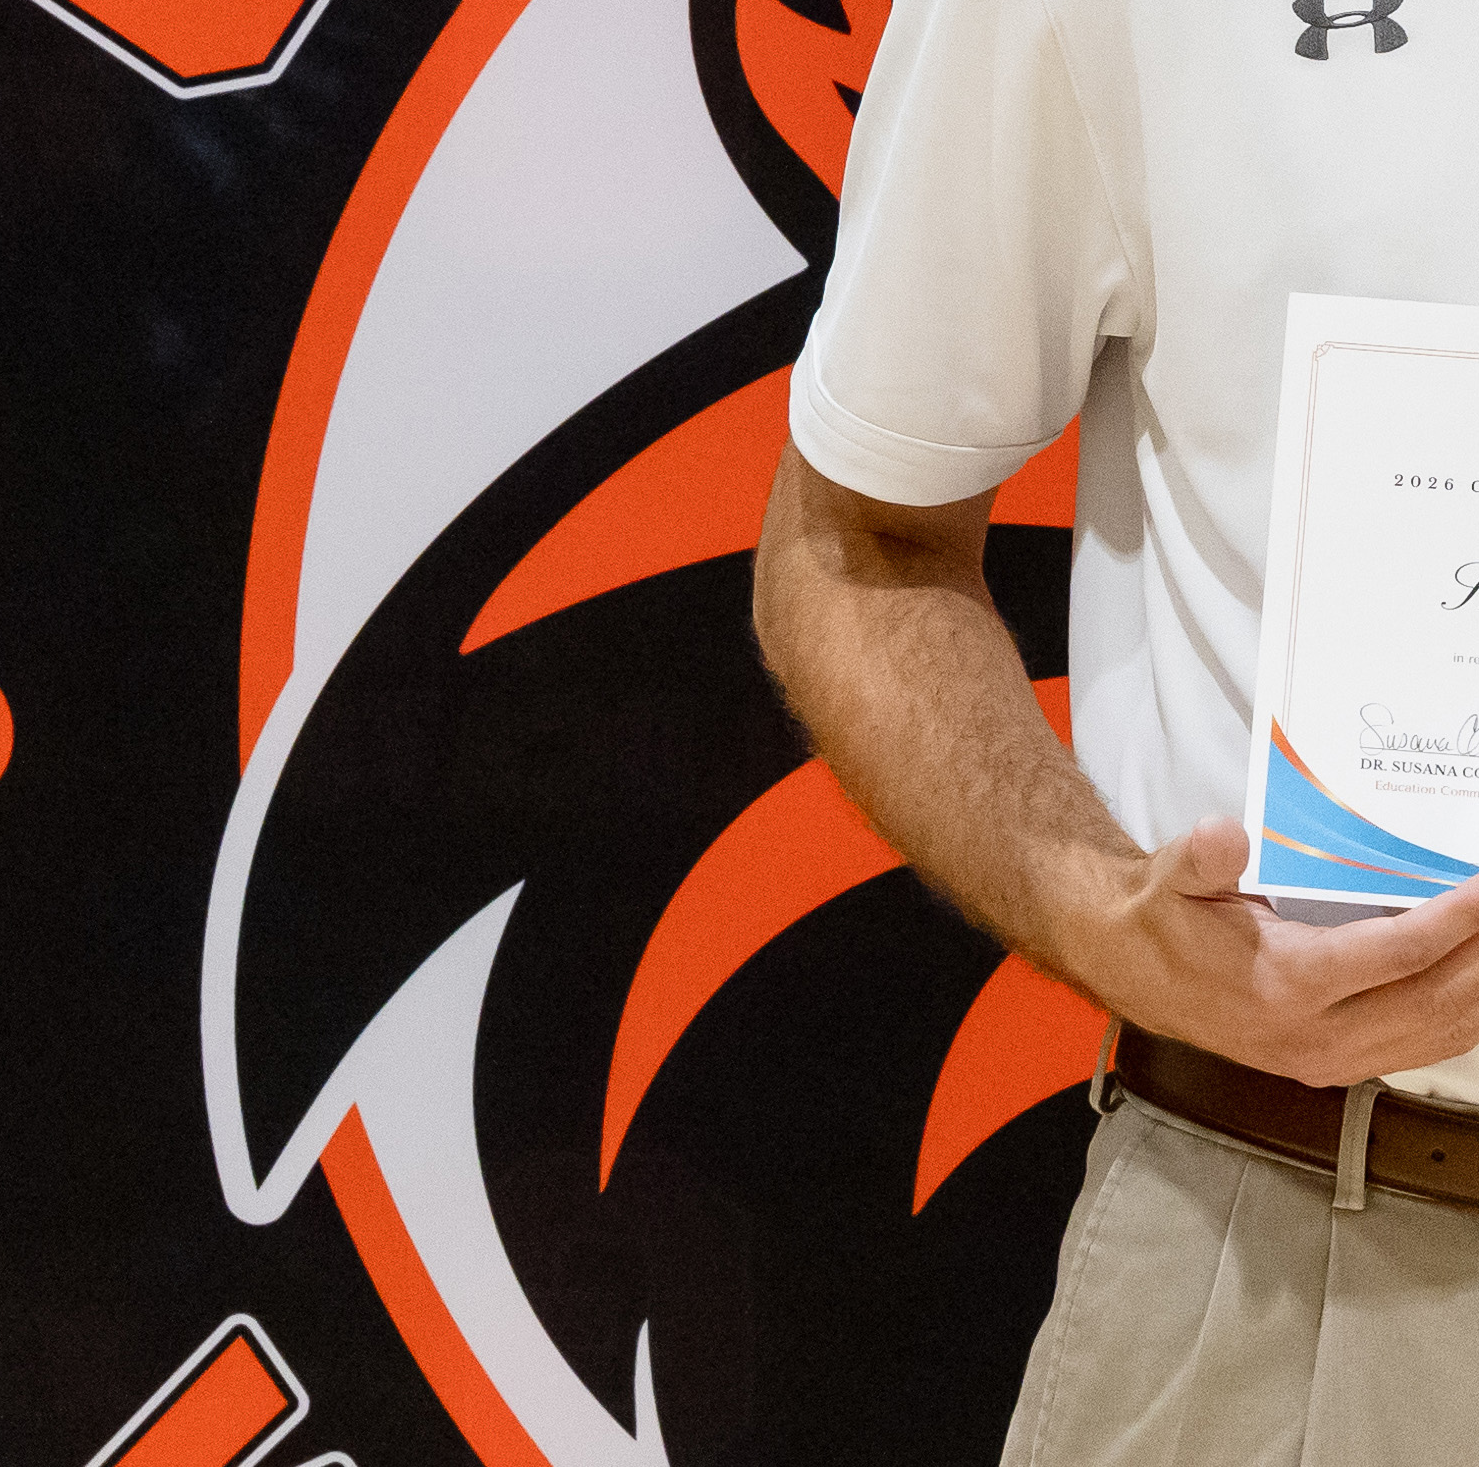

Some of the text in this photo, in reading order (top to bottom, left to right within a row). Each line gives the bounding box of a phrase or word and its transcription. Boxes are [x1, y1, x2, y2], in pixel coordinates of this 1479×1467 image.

[1394, 474, 1454, 491] 2026
[1453, 653, 1464, 663] in
[1360, 758, 1387, 772] DR.
[1392, 760, 1458, 777] SUSANA
[1375, 780, 1436, 796] Education
